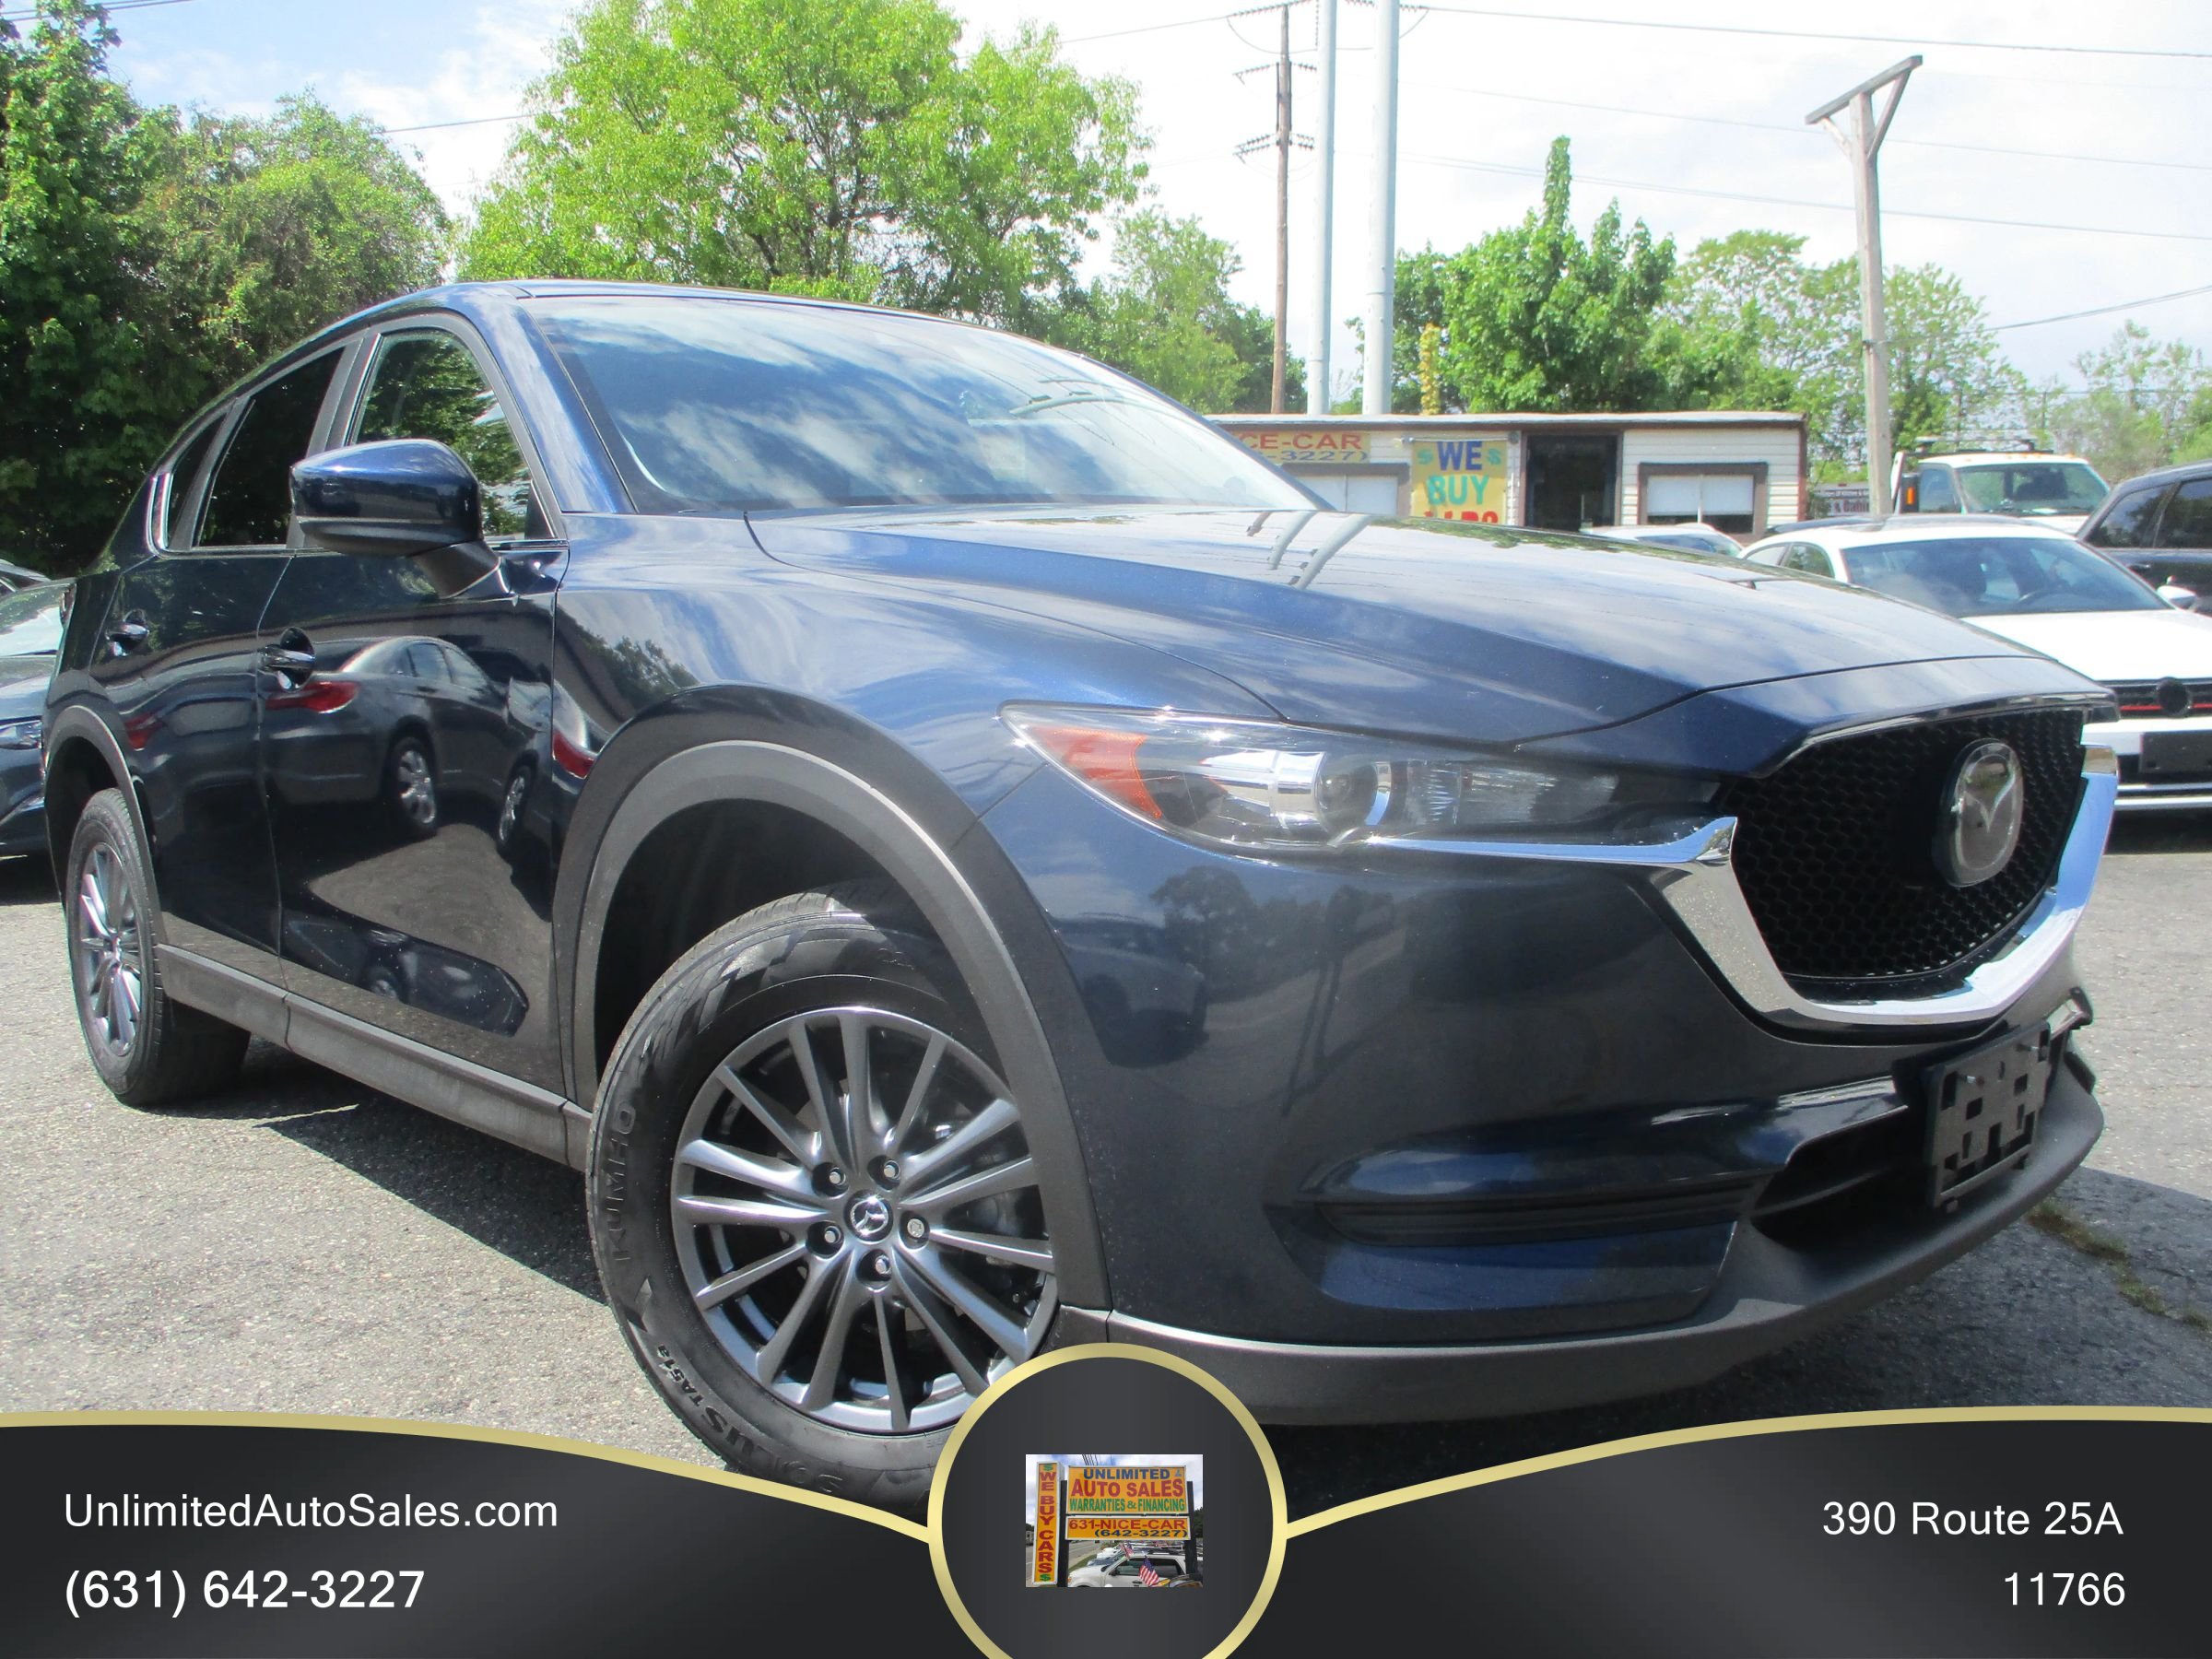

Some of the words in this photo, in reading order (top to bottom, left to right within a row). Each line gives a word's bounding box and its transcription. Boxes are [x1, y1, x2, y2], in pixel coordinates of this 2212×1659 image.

[1260, 451, 1368, 461] -3227)
[1437, 441, 1482, 471] WE
[1428, 475, 1489, 505] BUY
